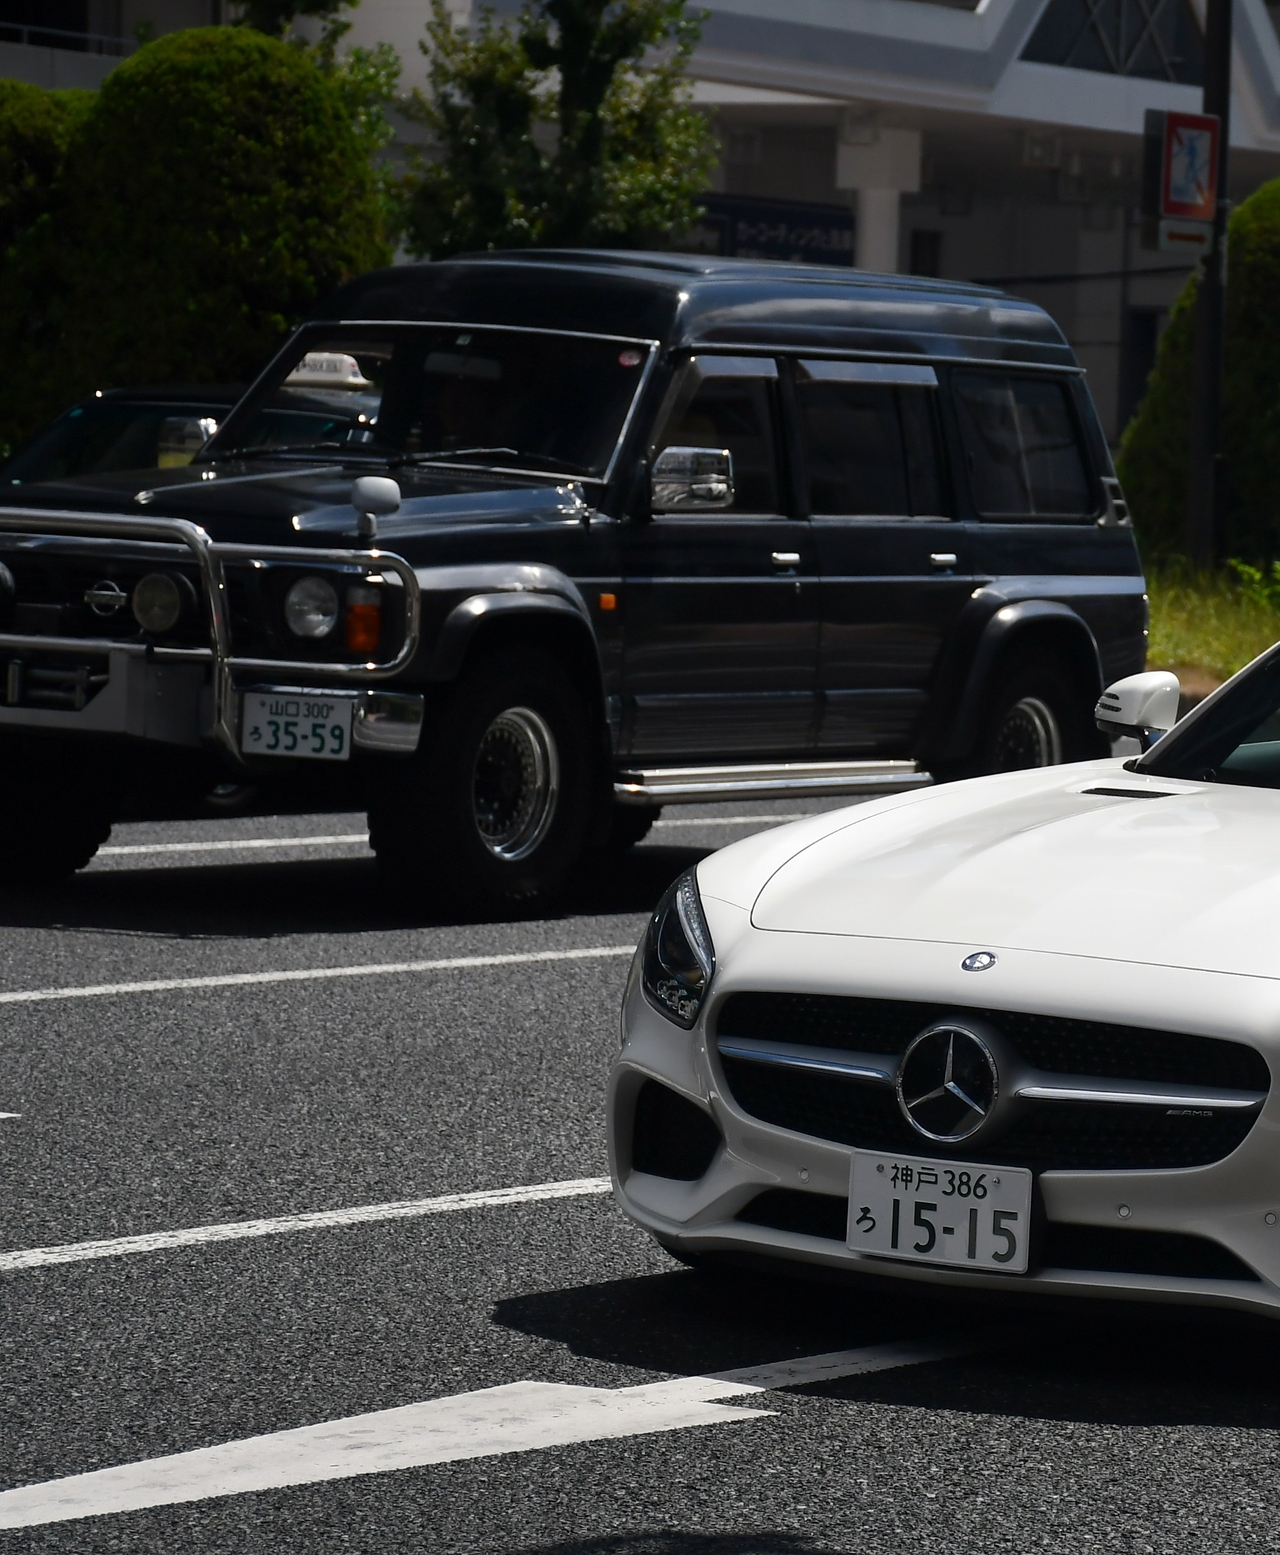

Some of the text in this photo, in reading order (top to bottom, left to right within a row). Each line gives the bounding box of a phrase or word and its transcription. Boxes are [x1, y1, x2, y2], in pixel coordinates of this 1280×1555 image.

[270, 701, 330, 719] 山口 300
[250, 720, 344, 755] ろ 35-59
[1180, 1109, 1214, 1117] AMG
[891, 1163, 989, 1200] 神戸 386
[856, 1198, 1019, 1264] ろ 15-15
